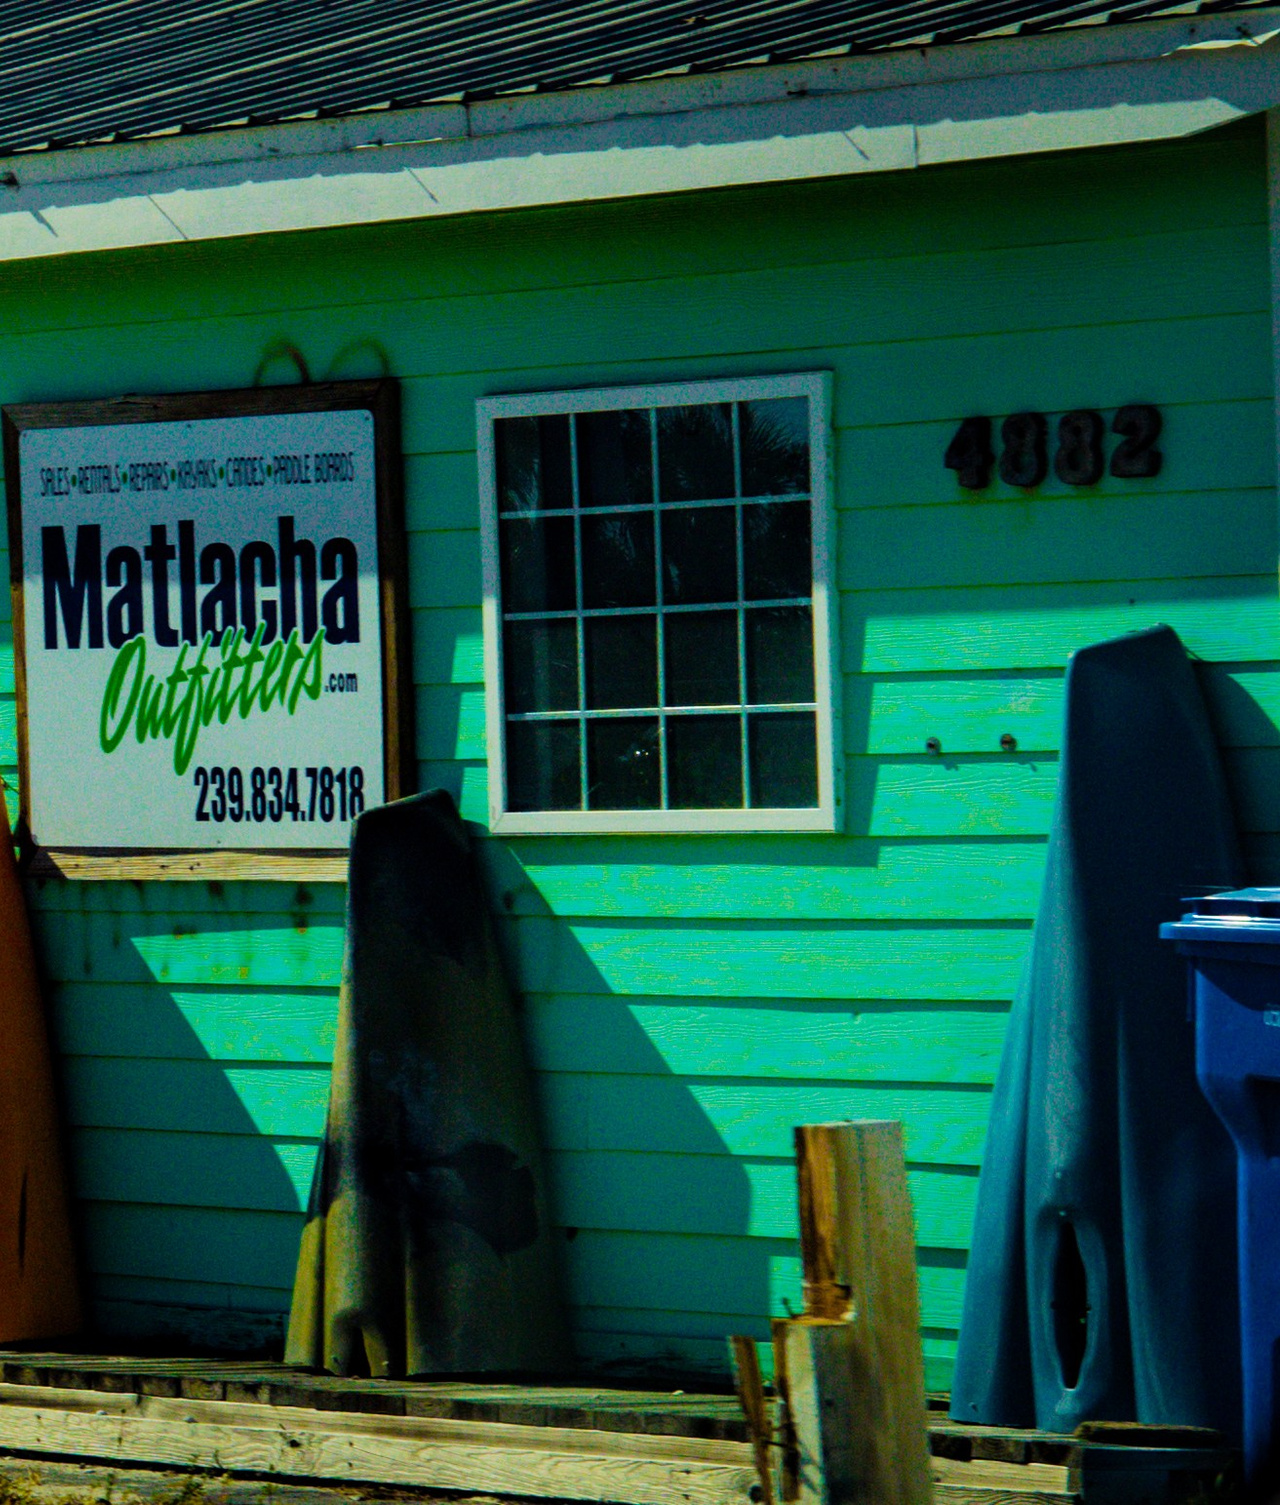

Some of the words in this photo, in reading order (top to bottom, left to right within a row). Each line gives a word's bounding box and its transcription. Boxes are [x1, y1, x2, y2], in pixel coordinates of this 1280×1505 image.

[39, 466, 71, 497] SALES
[78, 464, 121, 495] RENTALS
[129, 461, 170, 492] REPAIRS
[177, 458, 218, 490] KAYAKS
[226, 455, 266, 487] CANOES
[273, 453, 312, 485] PADDLE
[315, 451, 355, 484] BOARDS
[943, 403, 1163, 490] 4882
[40, 515, 361, 650] Matlacha
[99, 620, 327, 776] Outfitters
[324, 671, 359, 693] .com
[193, 765, 365, 823] 239.834.7818
